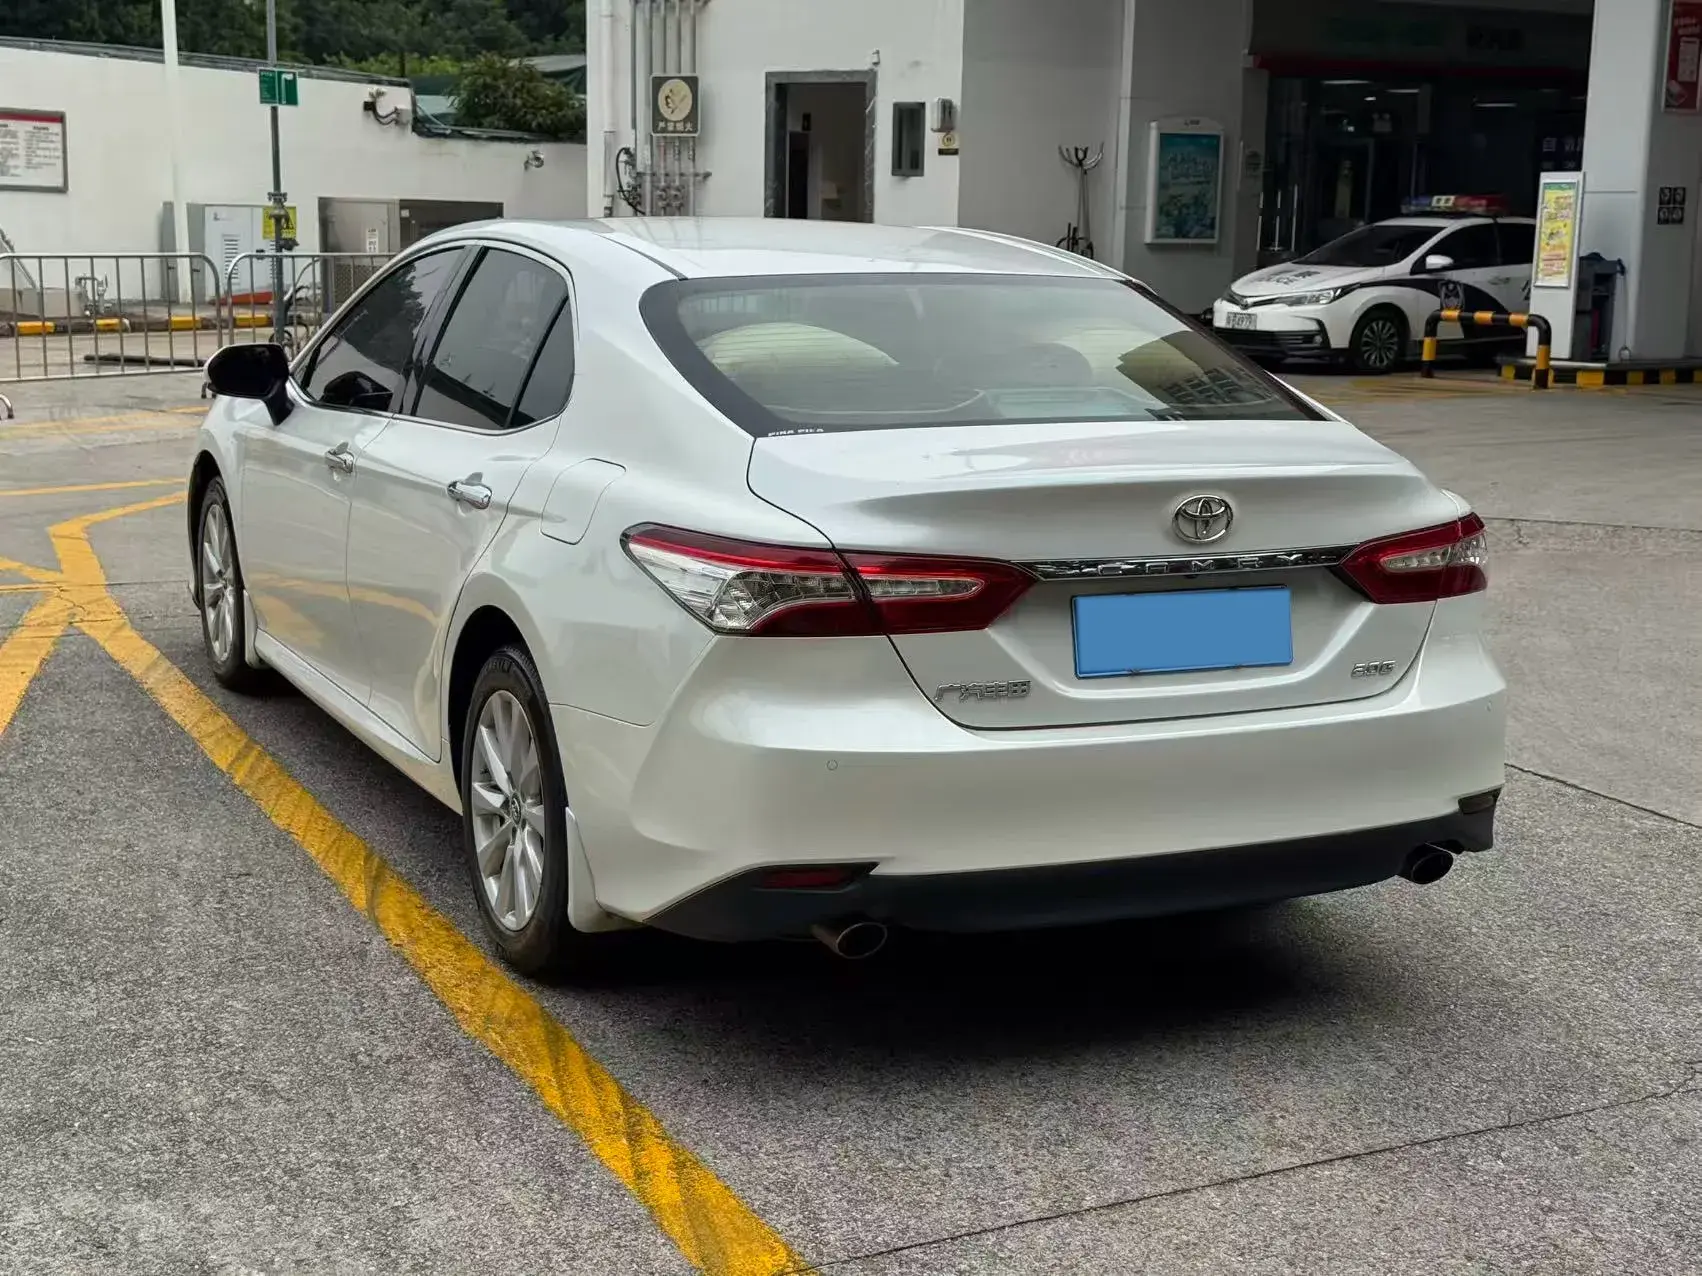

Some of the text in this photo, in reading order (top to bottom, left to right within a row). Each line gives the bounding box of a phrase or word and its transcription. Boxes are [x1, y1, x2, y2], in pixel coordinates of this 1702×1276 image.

[1097, 553, 1303, 575] CAMRY
[934, 680, 1031, 702] 广汽丰田
